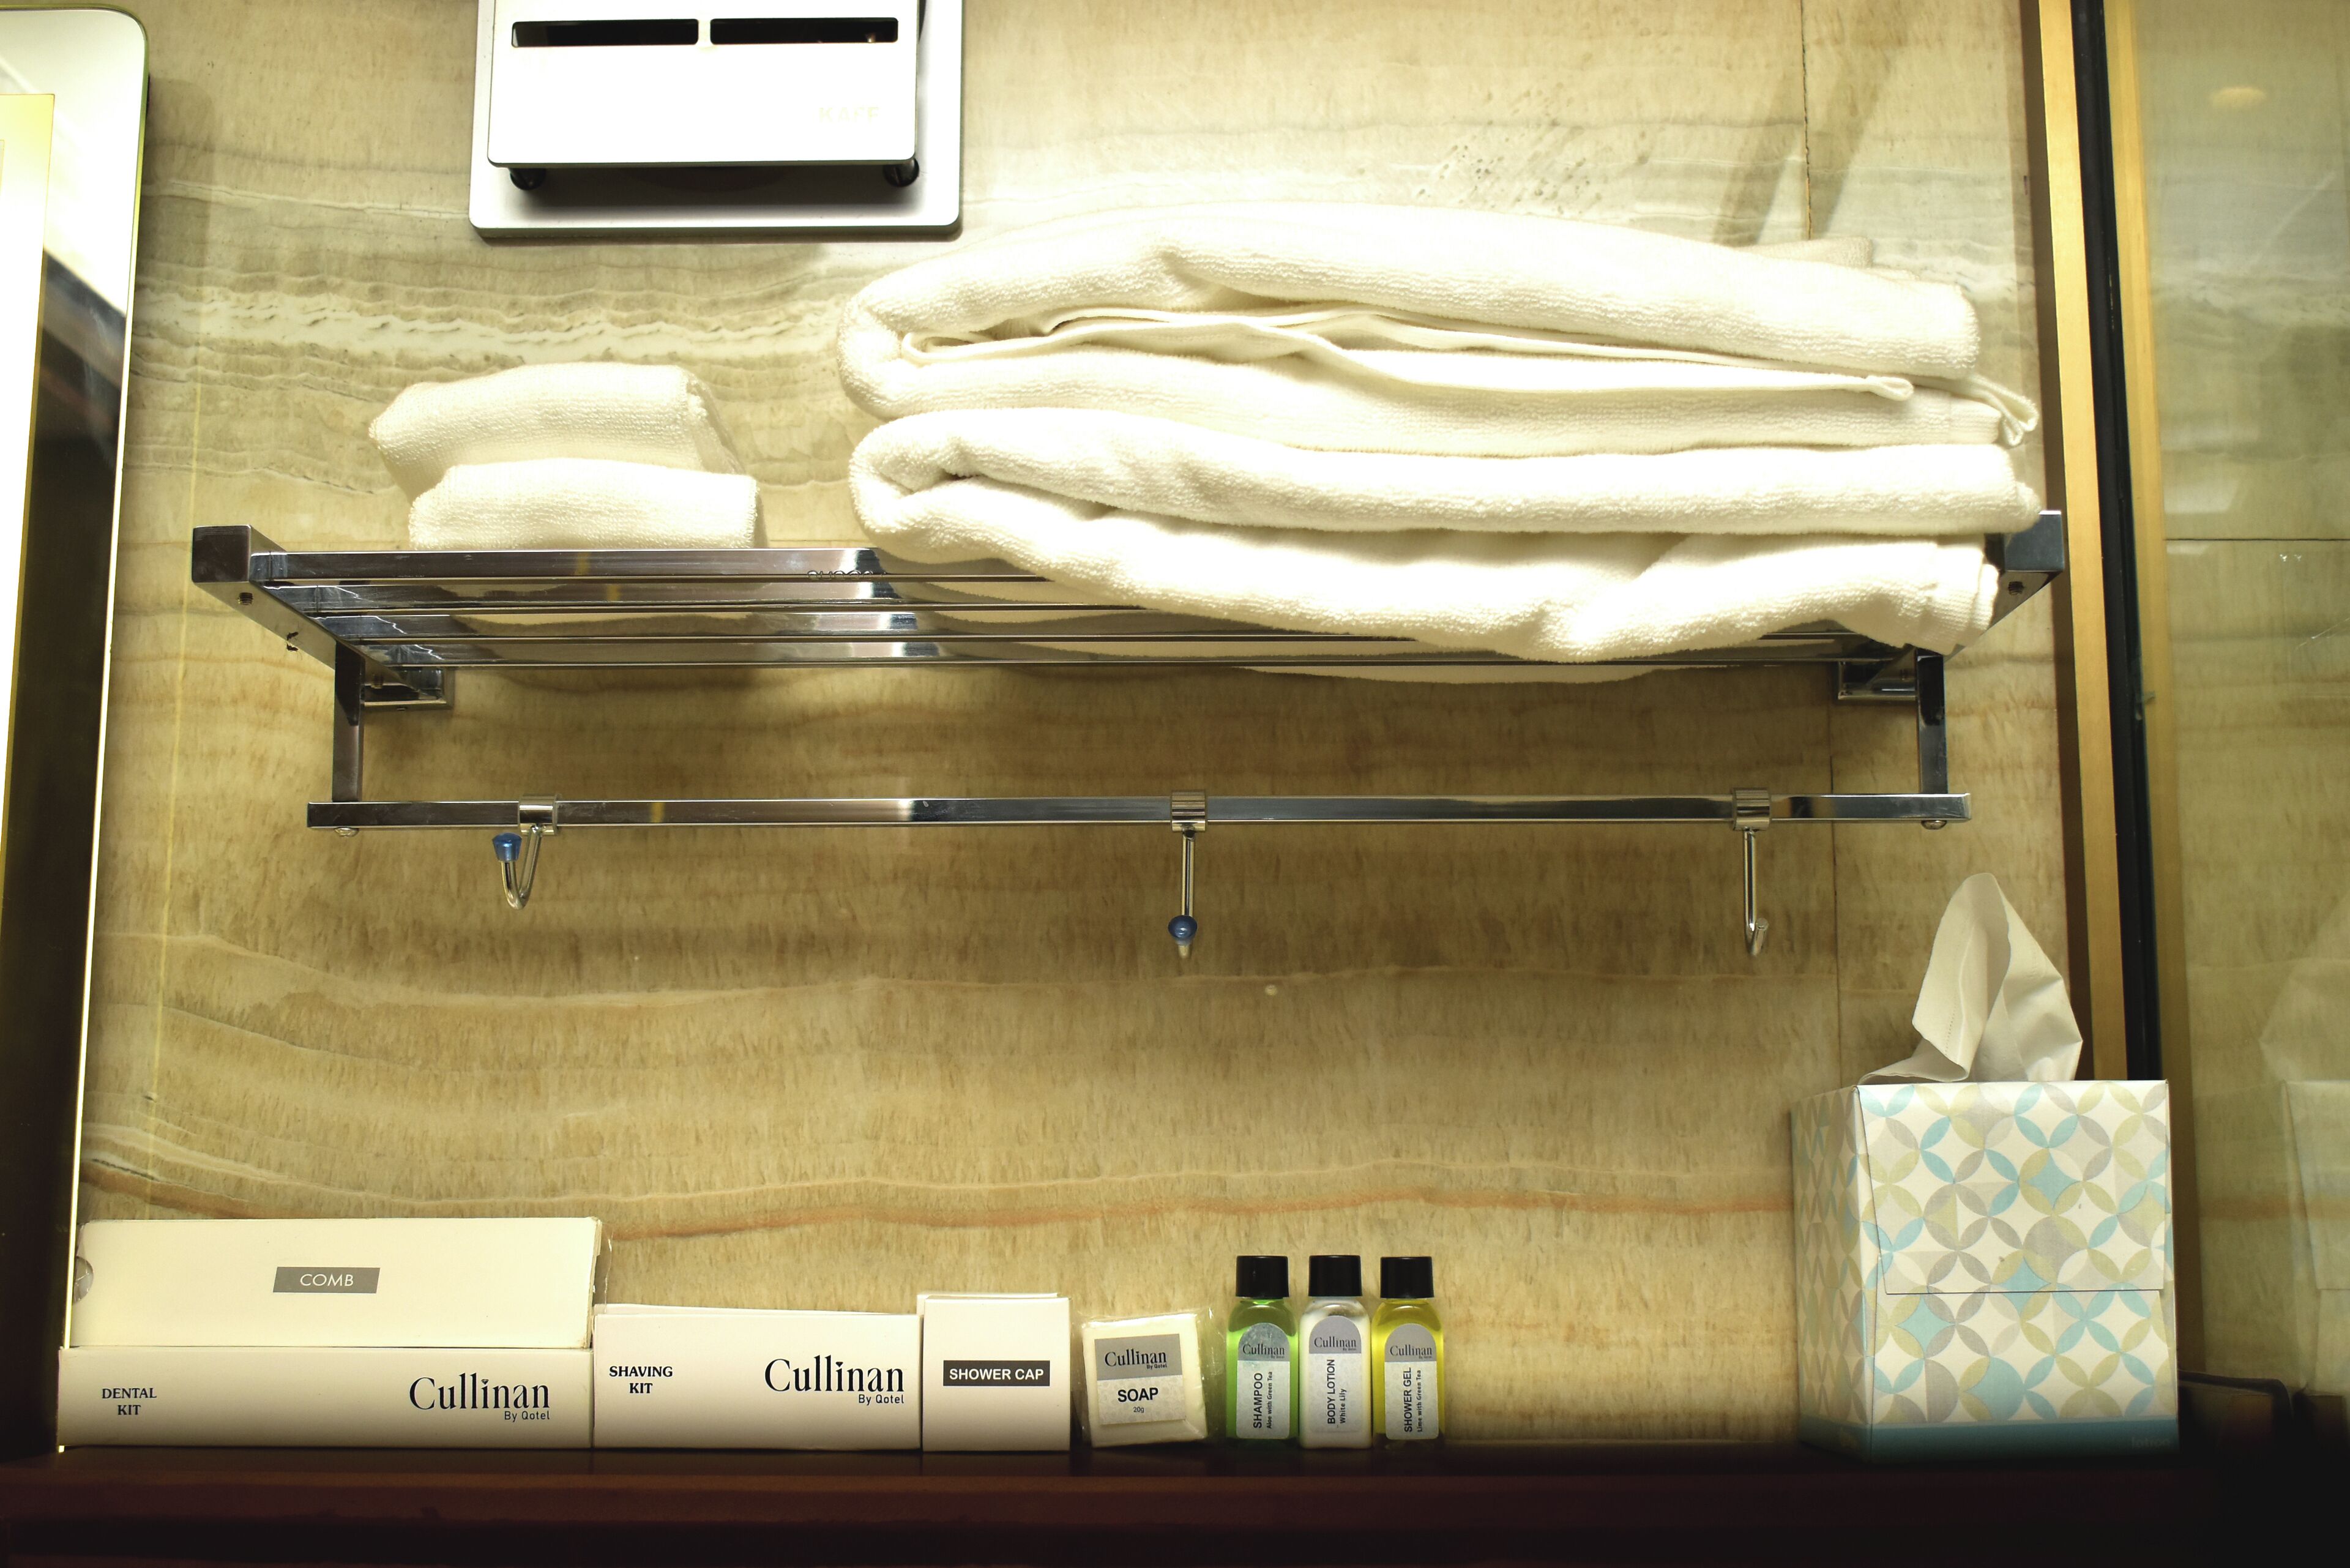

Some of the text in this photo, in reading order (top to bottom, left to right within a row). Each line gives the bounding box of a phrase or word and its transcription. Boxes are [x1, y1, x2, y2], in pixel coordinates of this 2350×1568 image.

[300, 1274, 354, 1286] COMB
[1314, 1336, 1356, 1348] Cullinan
[1390, 1345, 1432, 1356] Cullinan
[1105, 1348, 1166, 1367] Cullinan
[609, 1365, 673, 1378] SHAVING
[764, 1354, 905, 1392] Cullinan
[949, 1368, 1044, 1380] SHOWER CAP
[102, 1388, 157, 1399] DENTAL
[409, 1372, 550, 1410] Cullinan
[630, 1383, 653, 1394] KIT
[858, 1394, 905, 1406] By Qotel
[1117, 1387, 1158, 1403] SOAP
[1253, 1372, 1263, 1428] SHAMPOO
[118, 1405, 141, 1416] KIT
[1327, 1397, 1335, 1424] BODY
[1403, 1389, 1412, 1432] SHOWER
[504, 1411, 550, 1423] By Qotel
